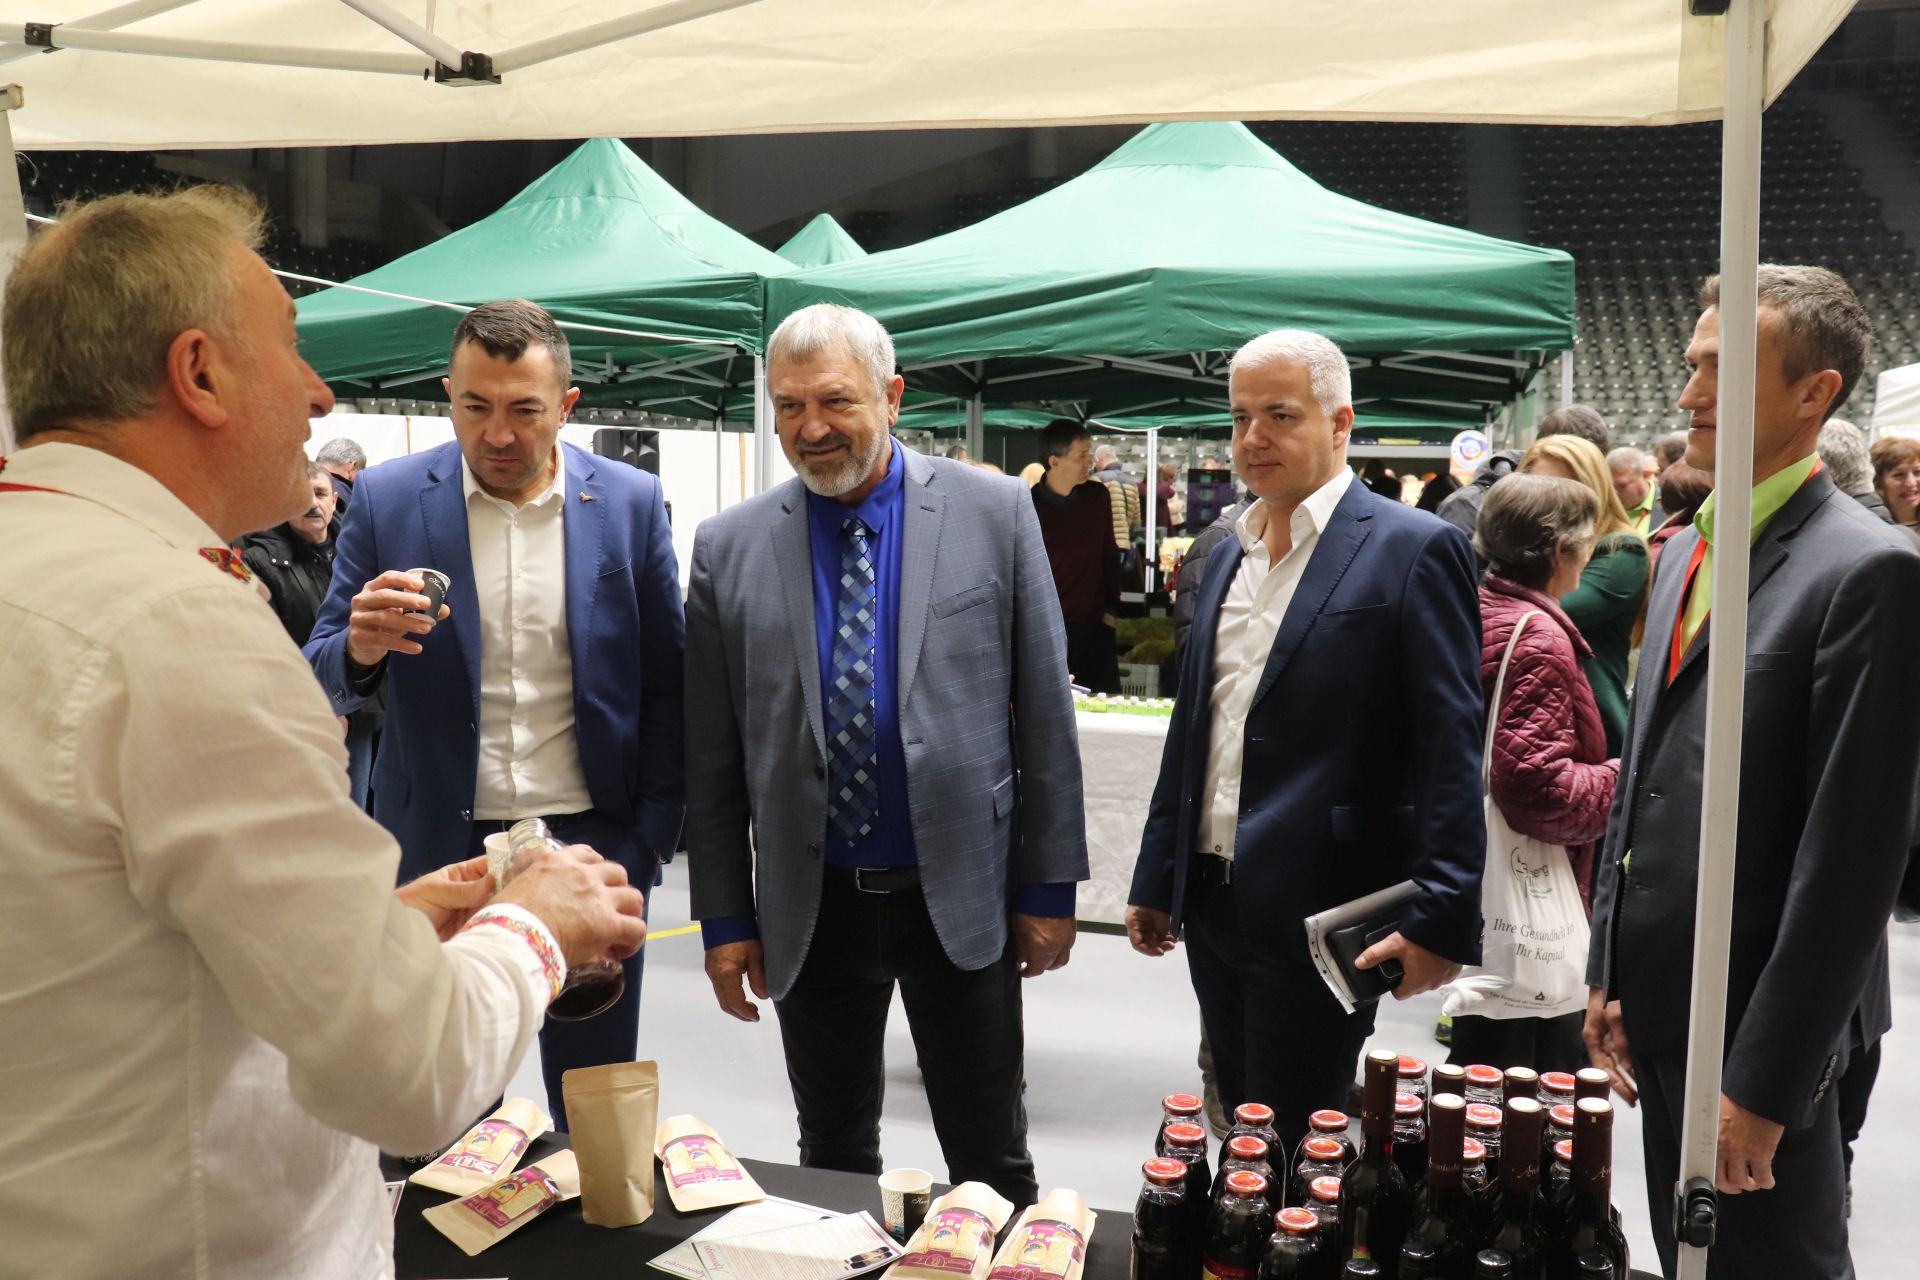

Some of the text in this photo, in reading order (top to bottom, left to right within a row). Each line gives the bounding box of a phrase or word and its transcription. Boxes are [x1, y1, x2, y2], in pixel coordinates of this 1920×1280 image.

[1493, 918, 1517, 934] Ihre
[1515, 943, 1565, 965] Ihr Kapital
